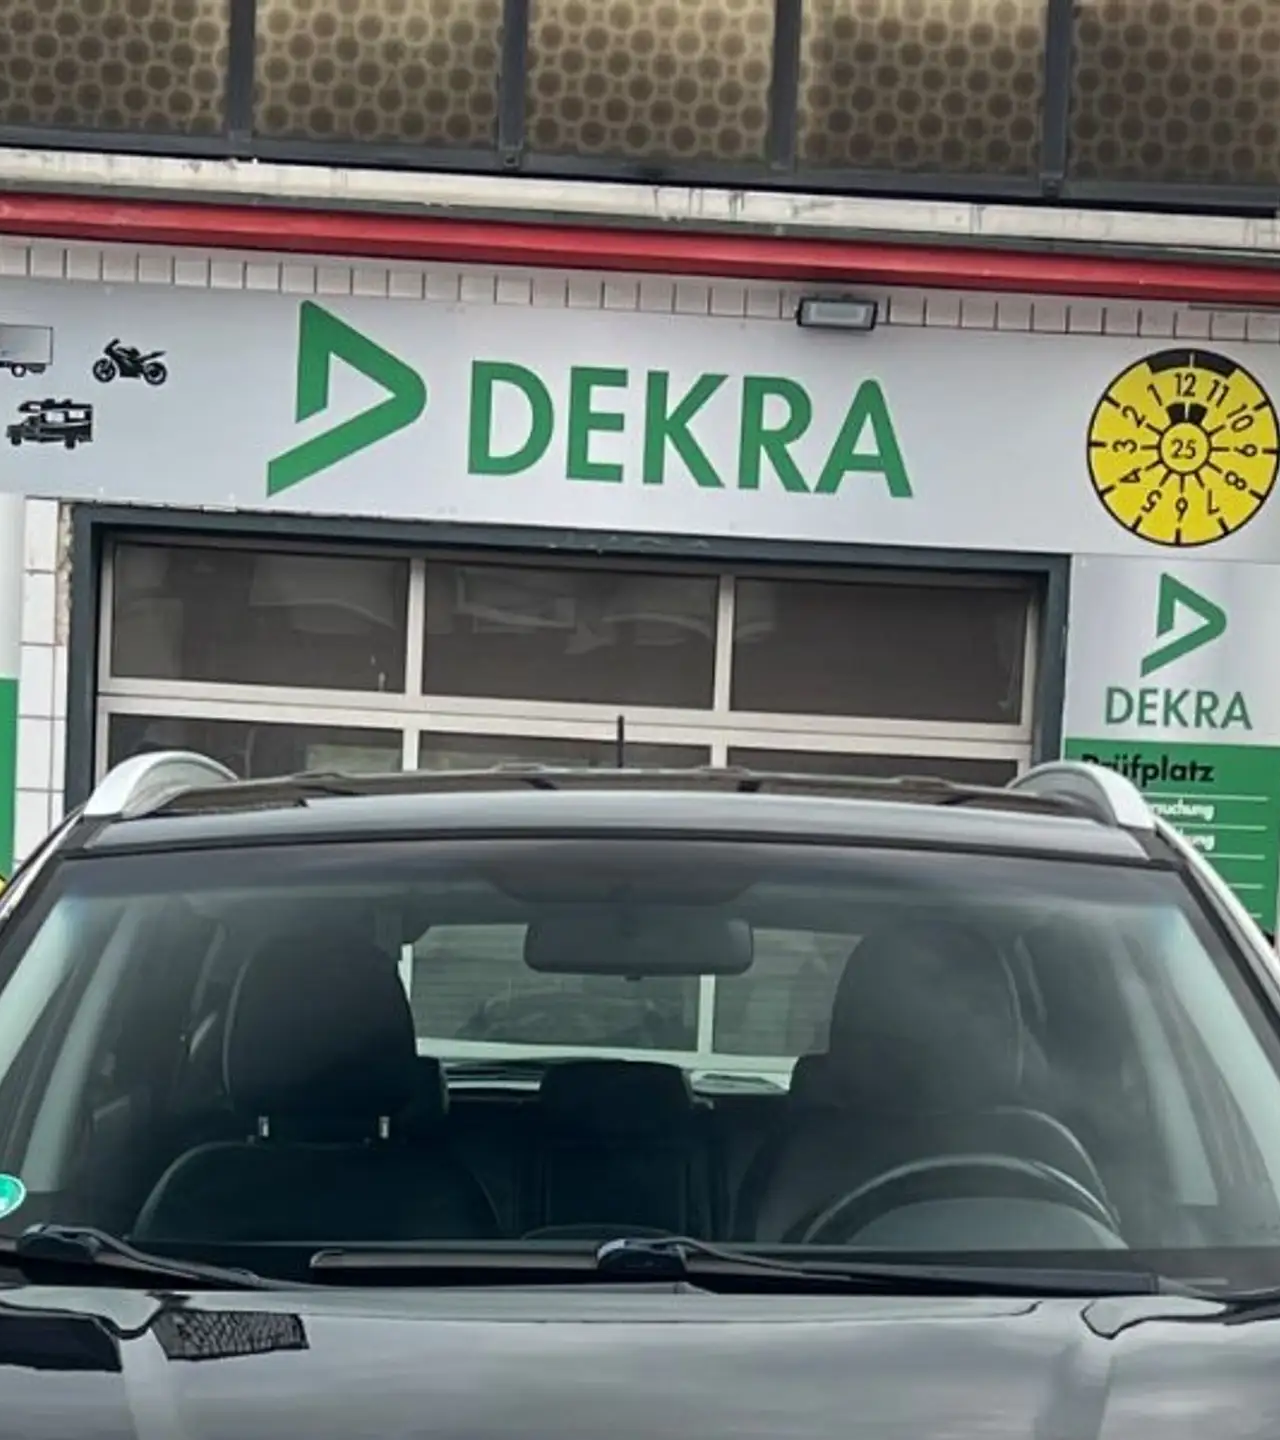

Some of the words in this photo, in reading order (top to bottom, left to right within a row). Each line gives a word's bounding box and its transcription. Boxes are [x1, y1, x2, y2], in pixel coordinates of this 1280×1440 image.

[1174, 372, 1197, 397] 12
[1207, 379, 1231, 408] 11
[467, 359, 914, 498] DEKRA
[1121, 404, 1146, 429] 2
[1226, 403, 1254, 432] 10
[1112, 438, 1138, 455] 3
[1170, 438, 1197, 460] 25
[1119, 467, 1142, 484] 4
[1224, 471, 1248, 491] 8
[1140, 489, 1163, 513] 5
[1105, 686, 1253, 731] DEKRA
